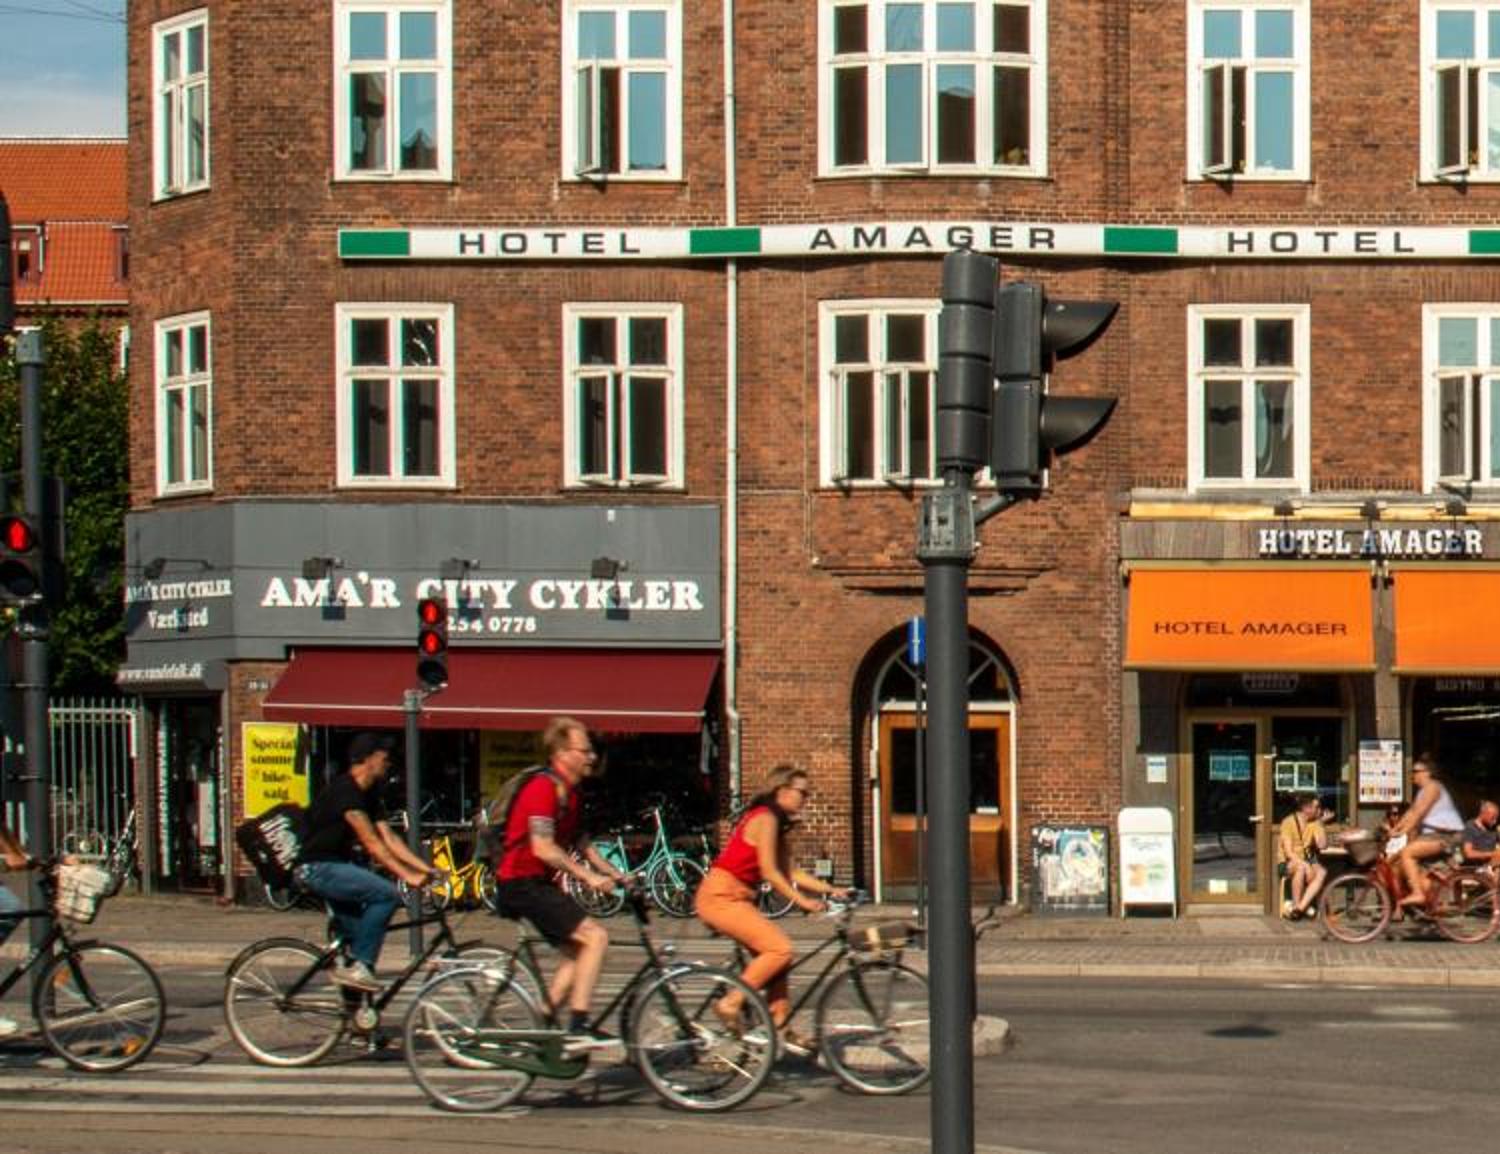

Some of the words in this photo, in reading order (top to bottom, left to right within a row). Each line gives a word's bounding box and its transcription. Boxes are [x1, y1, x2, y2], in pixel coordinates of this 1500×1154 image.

[459, 232, 640, 254] HOTEL
[810, 226, 1055, 250] AMAGER
[1228, 232, 1414, 253] HOTEL
[1259, 529, 1351, 554] HOTEL
[1360, 529, 1483, 554] AMAGER
[160, 582, 187, 601] CITY
[260, 571, 401, 608] AMA'R
[416, 578, 517, 609] CITY
[529, 579, 703, 610] CYKLER
[447, 615, 483, 632] 254
[488, 616, 536, 633] 0778
[1154, 621, 1233, 635] HOTEL
[1241, 622, 1347, 636] AMAGER
[251, 754, 294, 765] somme
